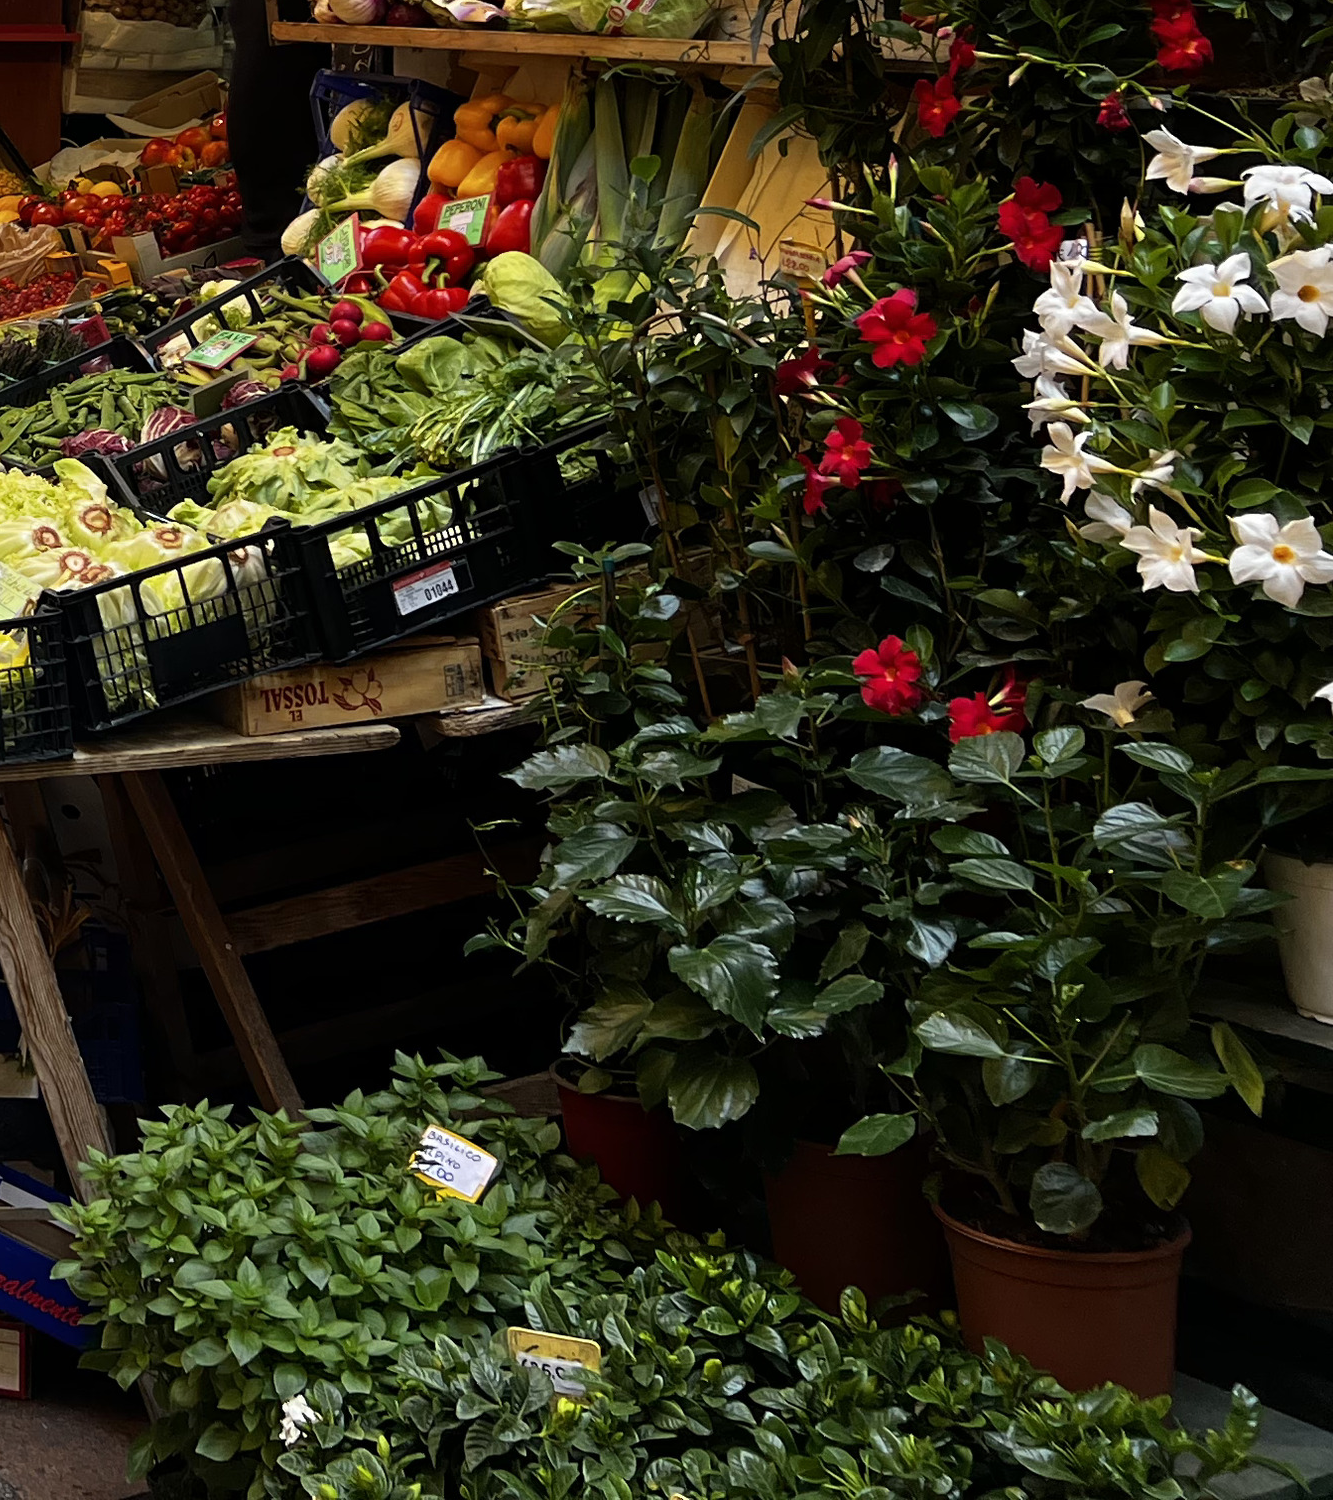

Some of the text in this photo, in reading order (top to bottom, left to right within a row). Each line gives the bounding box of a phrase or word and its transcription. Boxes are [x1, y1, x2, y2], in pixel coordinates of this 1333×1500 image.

[444, 196, 488, 217] PEPERONI
[424, 579, 454, 601] 01044
[260, 680, 329, 722] EL TOSSAL
[426, 1130, 482, 1163] BASILICO
